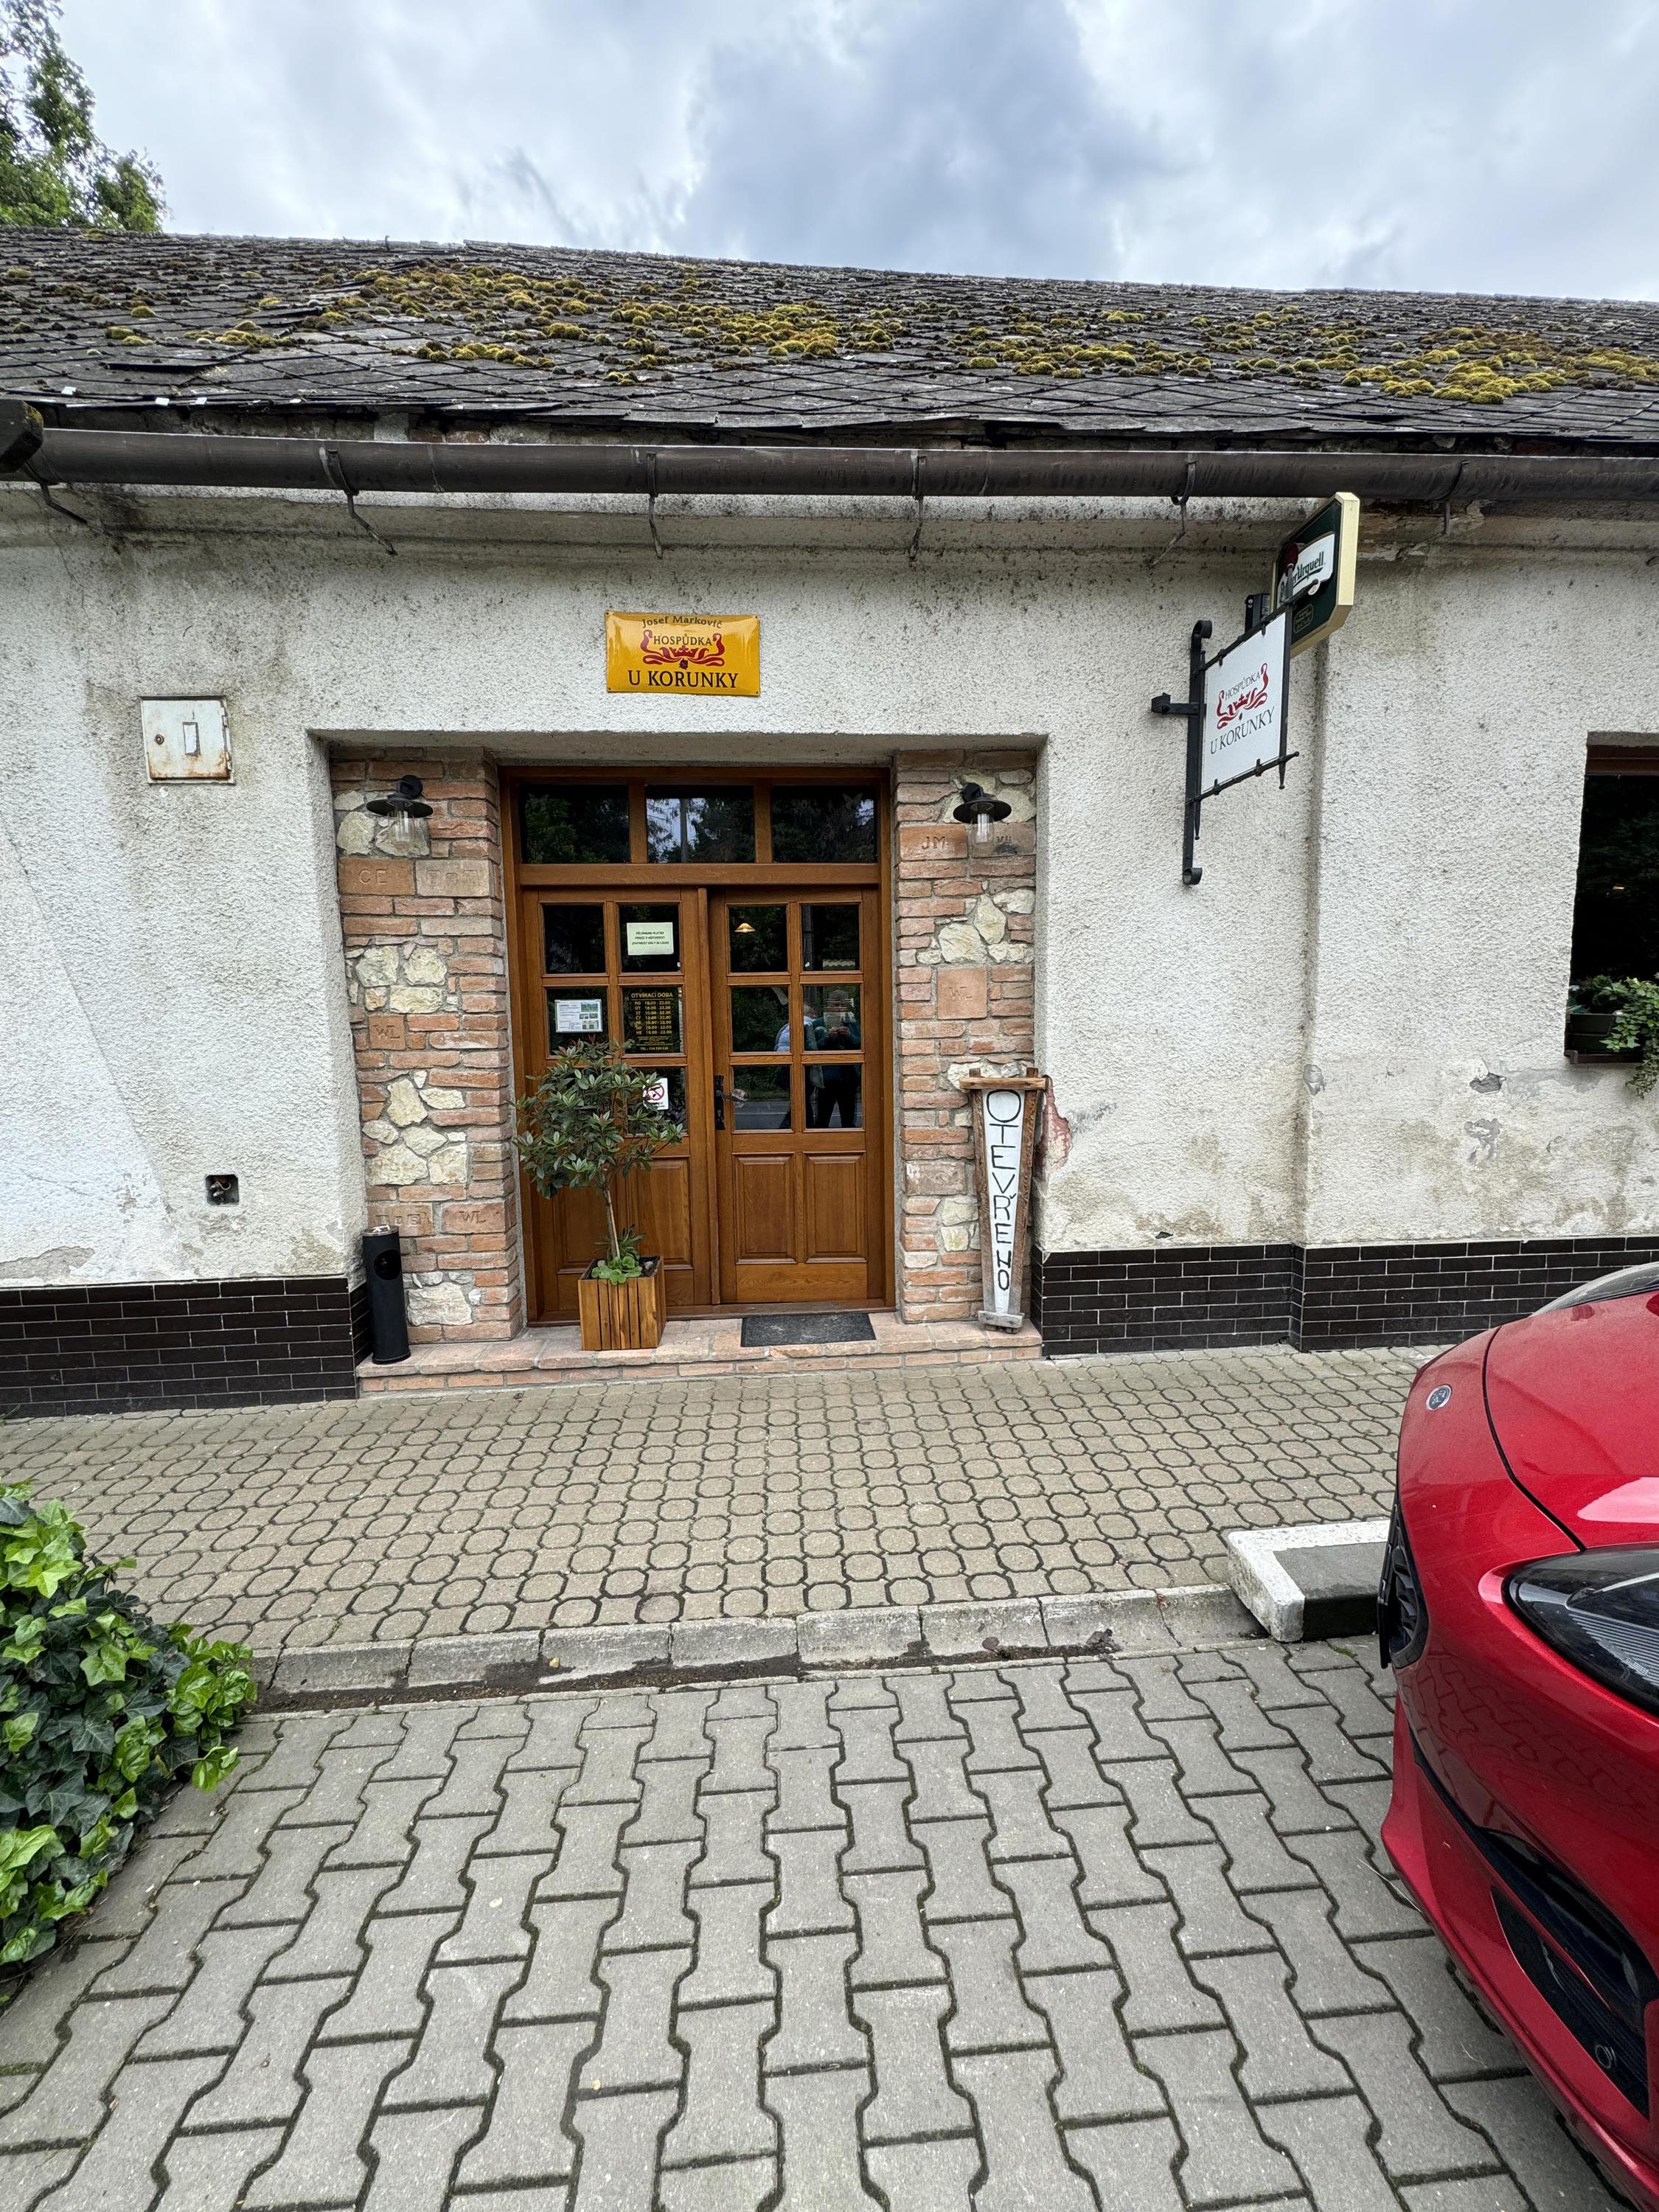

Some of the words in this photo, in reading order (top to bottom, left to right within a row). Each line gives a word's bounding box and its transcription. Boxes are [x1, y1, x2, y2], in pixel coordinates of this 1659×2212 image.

[1297, 552, 1324, 580] Urquell
[641, 616, 669, 628] Josef
[672, 616, 723, 628] Markovič
[653, 633, 712, 646] HOSPŮDKA
[627, 669, 641, 686] U
[648, 670, 738, 688] KORUNKY
[1225, 671, 1260, 700] HOSPŮDKA
[1210, 738, 1217, 754] U
[1219, 706, 1274, 751] KORUNKY
[359, 869, 388, 885] CE
[987, 1089, 1021, 1291] OTEVŘENO
